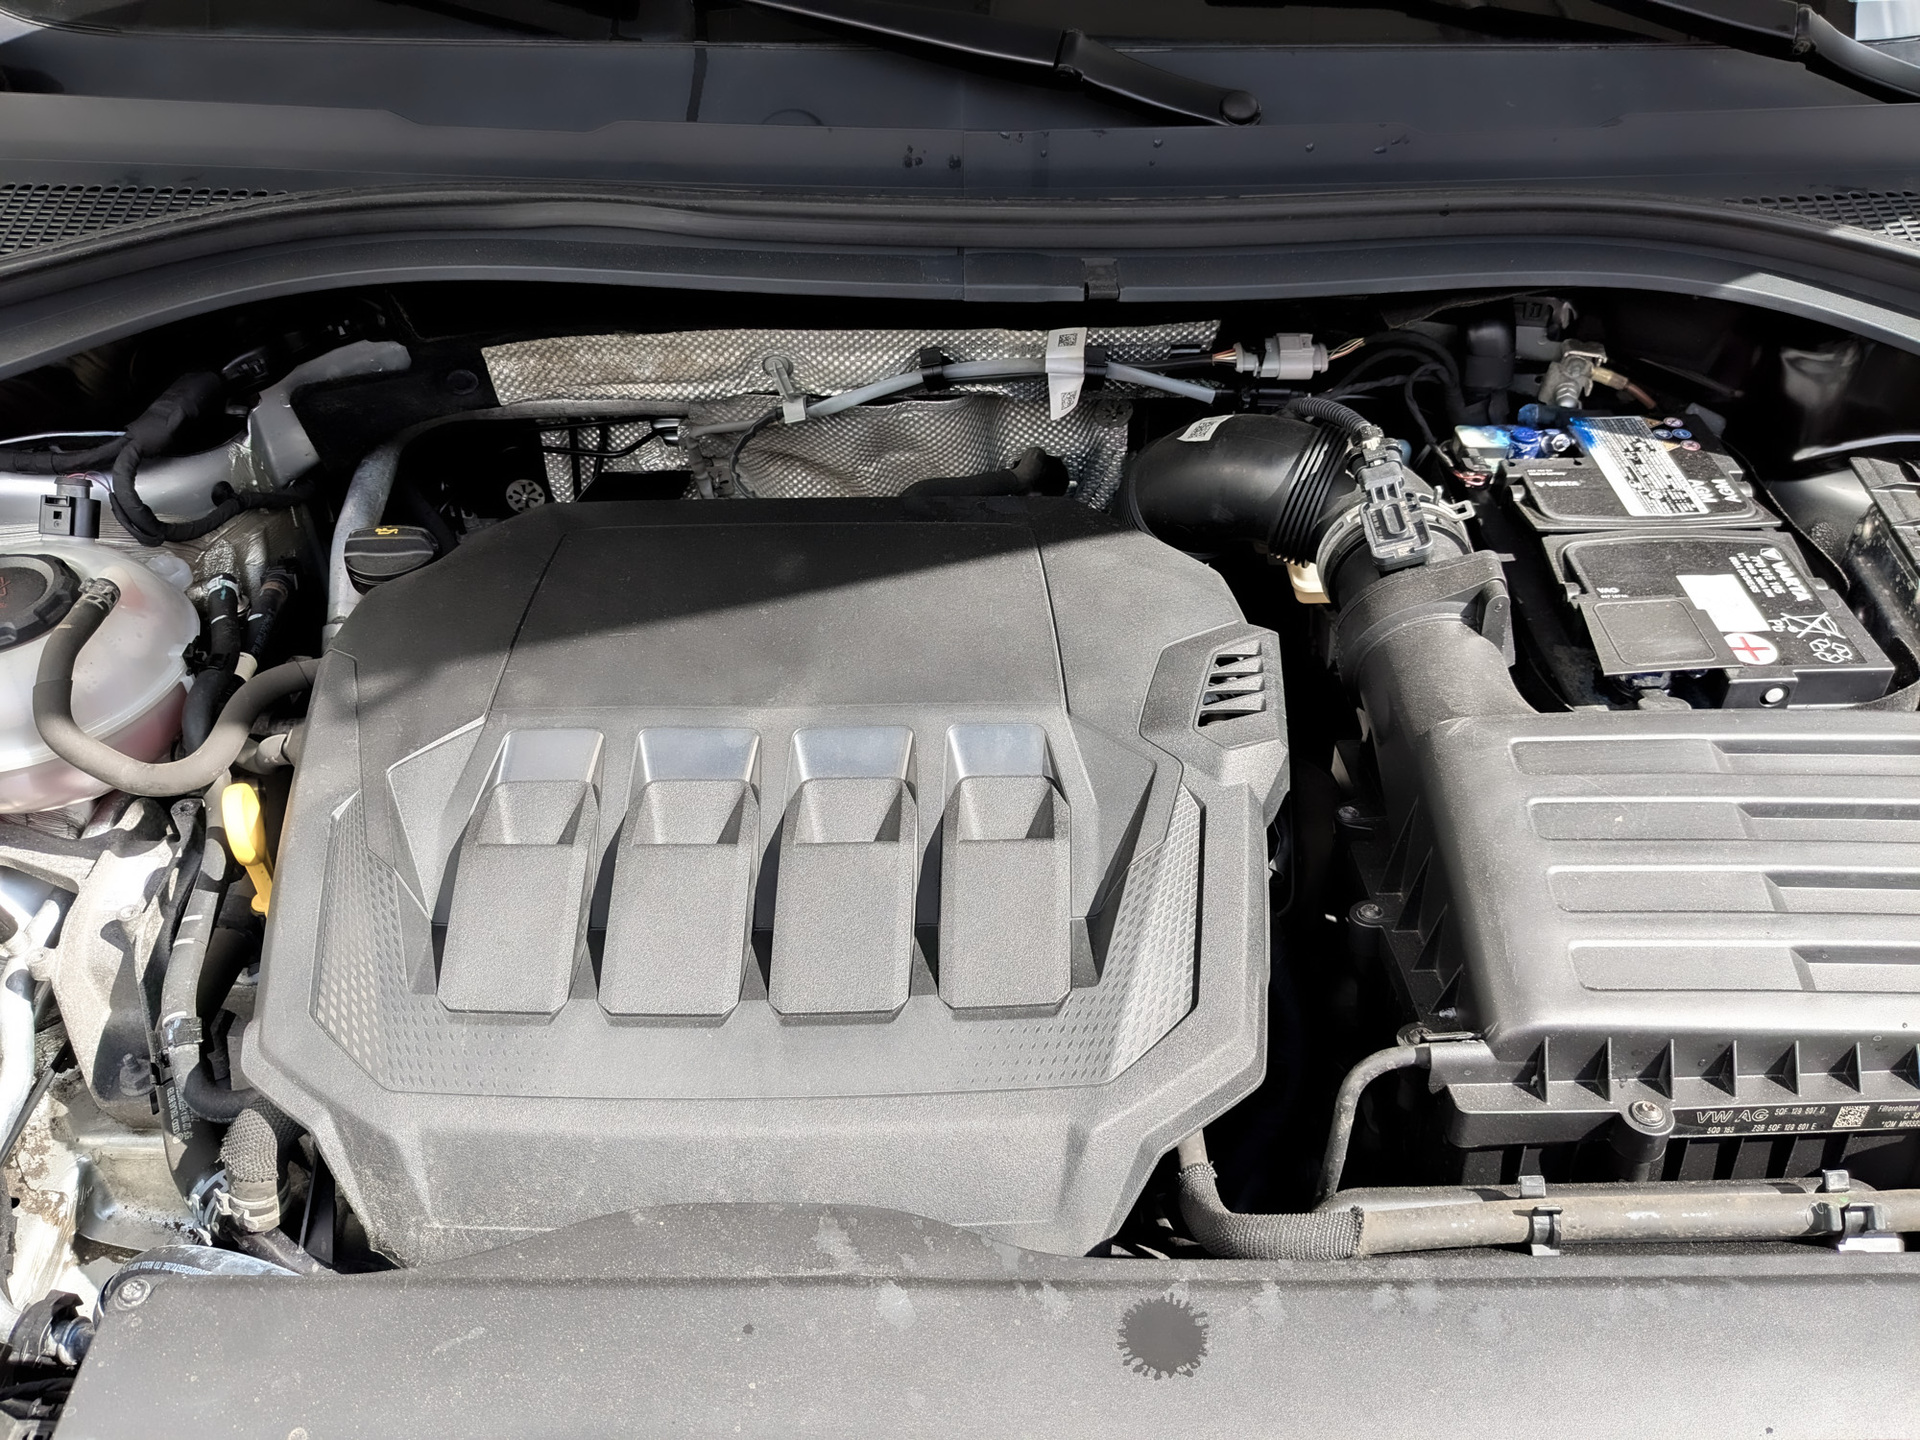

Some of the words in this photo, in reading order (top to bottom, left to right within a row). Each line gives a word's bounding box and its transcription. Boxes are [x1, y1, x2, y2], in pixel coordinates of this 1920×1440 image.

[1687, 478, 1718, 503] AGM
[1711, 478, 1742, 503] AGM
[1771, 560, 1813, 602] VARTA
[1768, 619, 1786, 632] Pb
[1696, 1110, 1734, 1124] VW
[1734, 1108, 1769, 1122] AG
